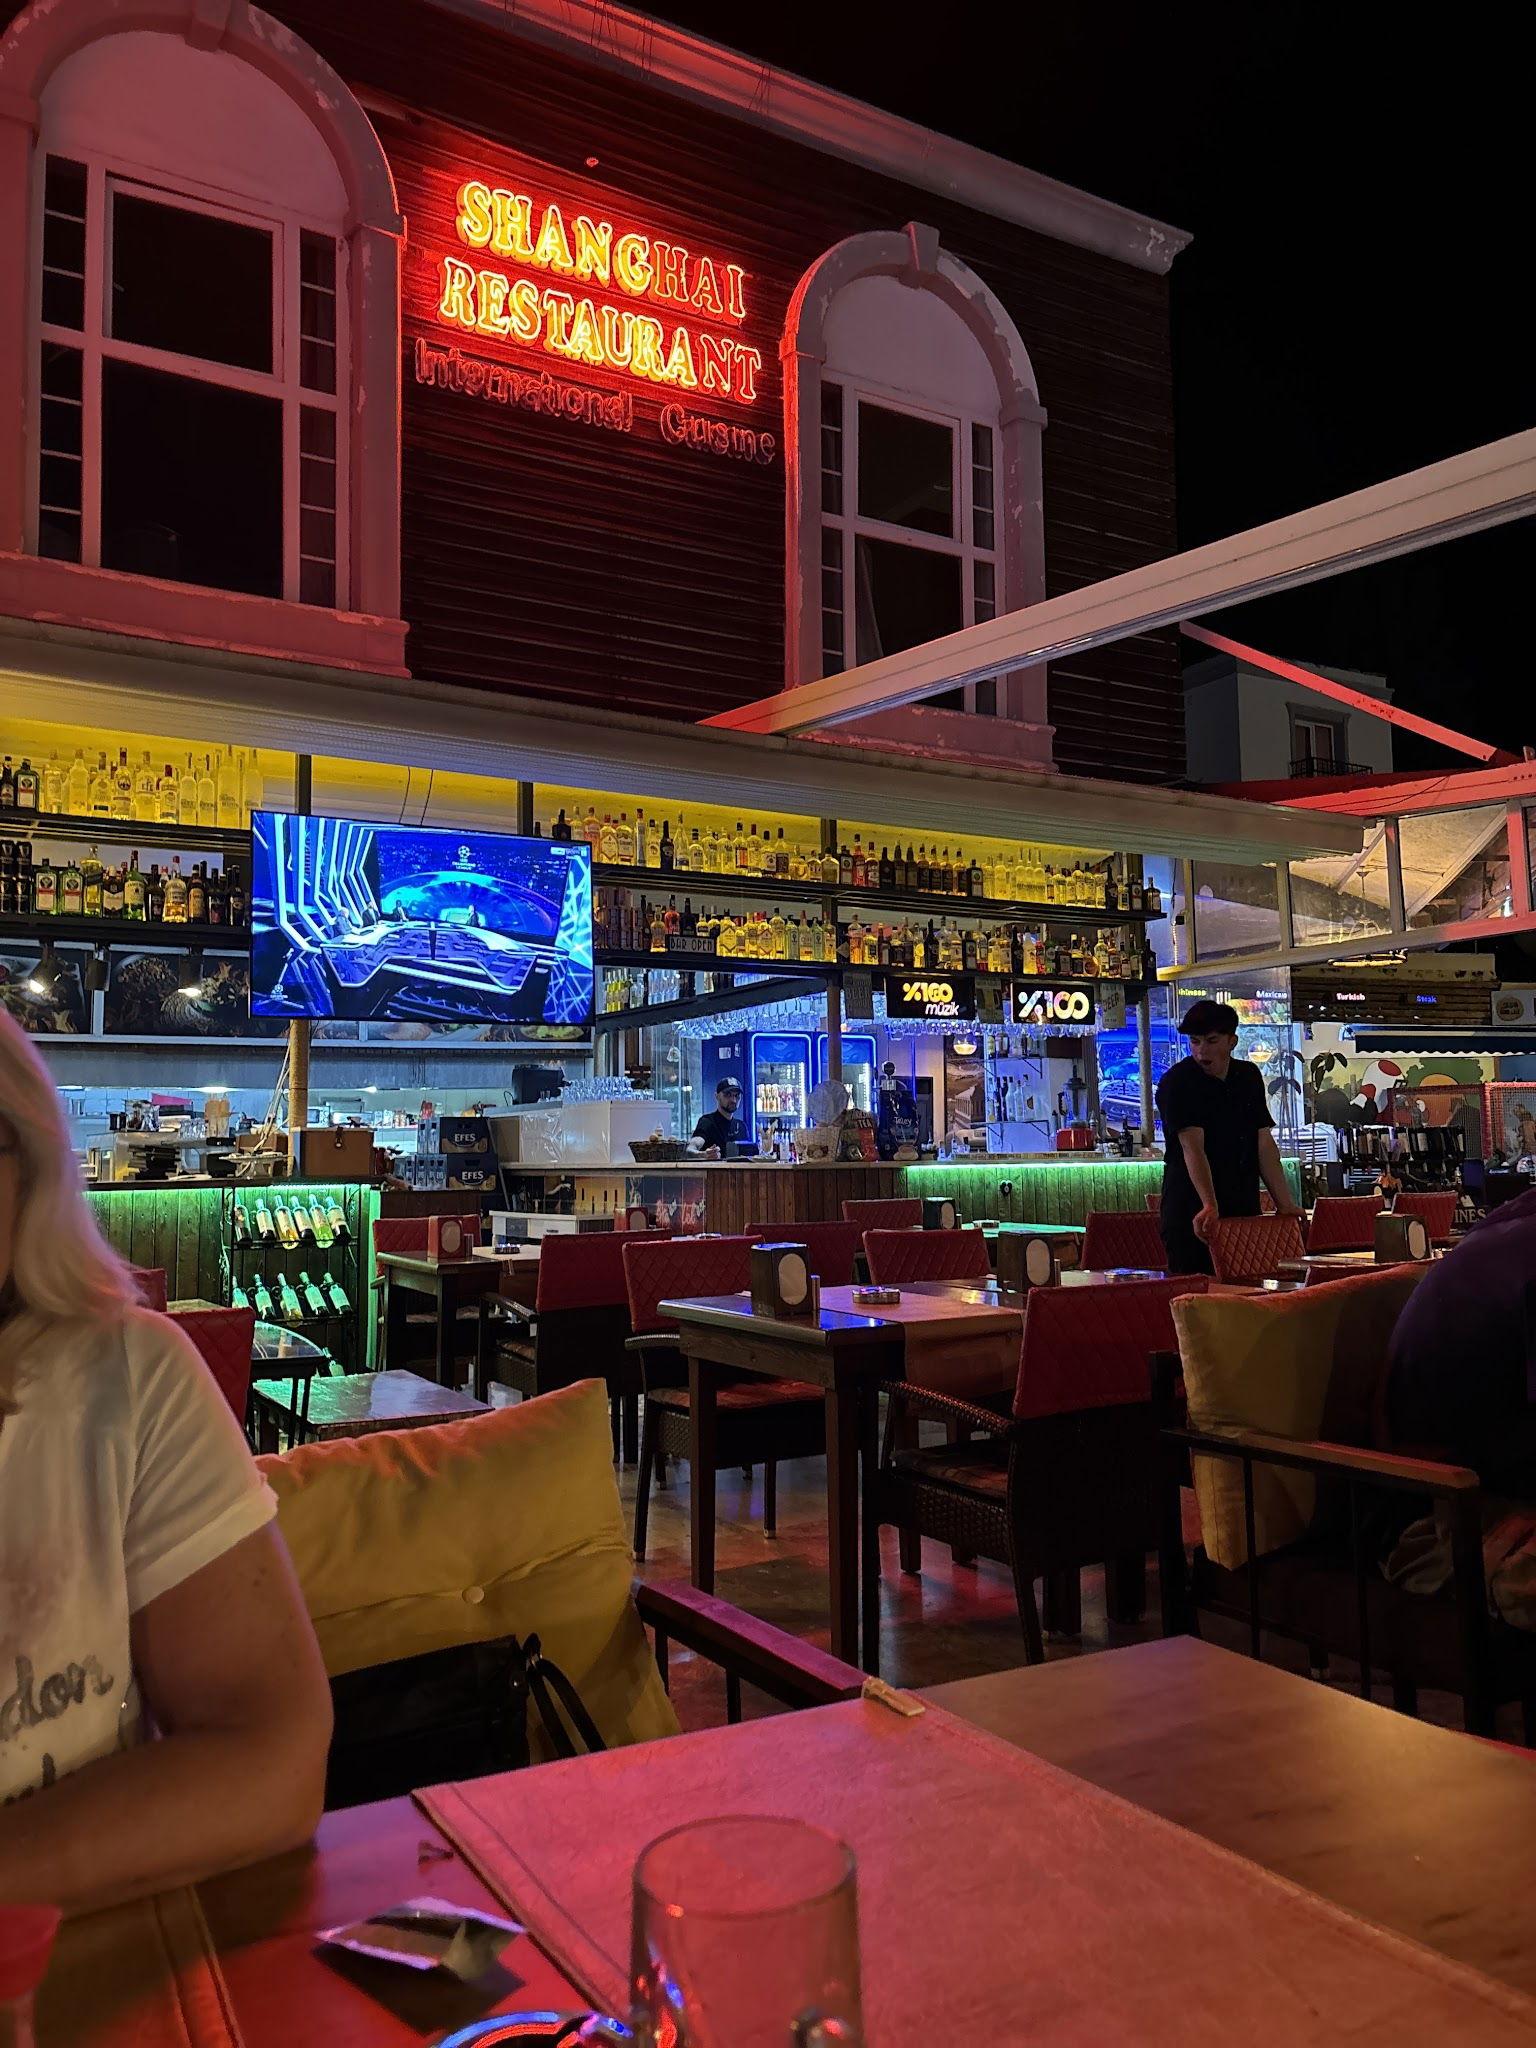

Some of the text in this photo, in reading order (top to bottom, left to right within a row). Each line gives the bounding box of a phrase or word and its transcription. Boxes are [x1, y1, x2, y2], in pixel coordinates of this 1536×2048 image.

[457, 181, 746, 324] SHANGHAI
[438, 256, 762, 403] RESTAURANT
[415, 337, 775, 465] International Cuisine
[670, 938, 687, 950] BAR
[902, 982, 954, 1003] %100
[1336, 993, 1366, 1001] Turkish
[1416, 995, 1437, 1003] Steak
[925, 1002, 960, 1016] müzik
[1018, 990, 1090, 1020] %100
[454, 1133, 476, 1142] EFES
[461, 1171, 484, 1180] EFES
[1454, 1208, 1487, 1223] INES
